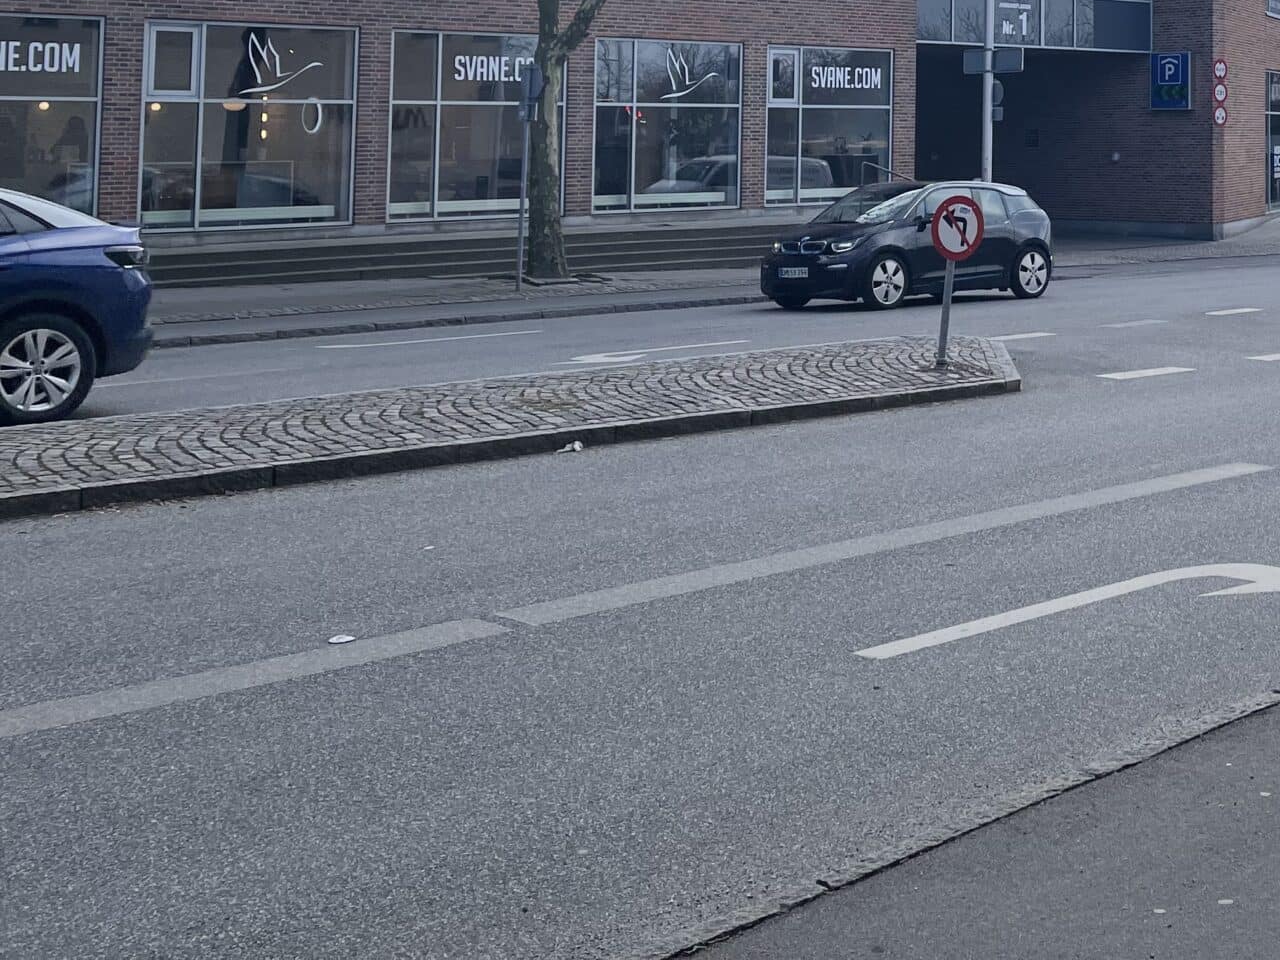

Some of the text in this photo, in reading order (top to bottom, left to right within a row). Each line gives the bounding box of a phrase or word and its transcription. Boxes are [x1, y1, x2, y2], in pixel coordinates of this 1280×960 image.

[1002, 11, 1028, 36] Nr. 1
[811, 66, 881, 89] SVANE.COM
[1165, 63, 1175, 81] P
